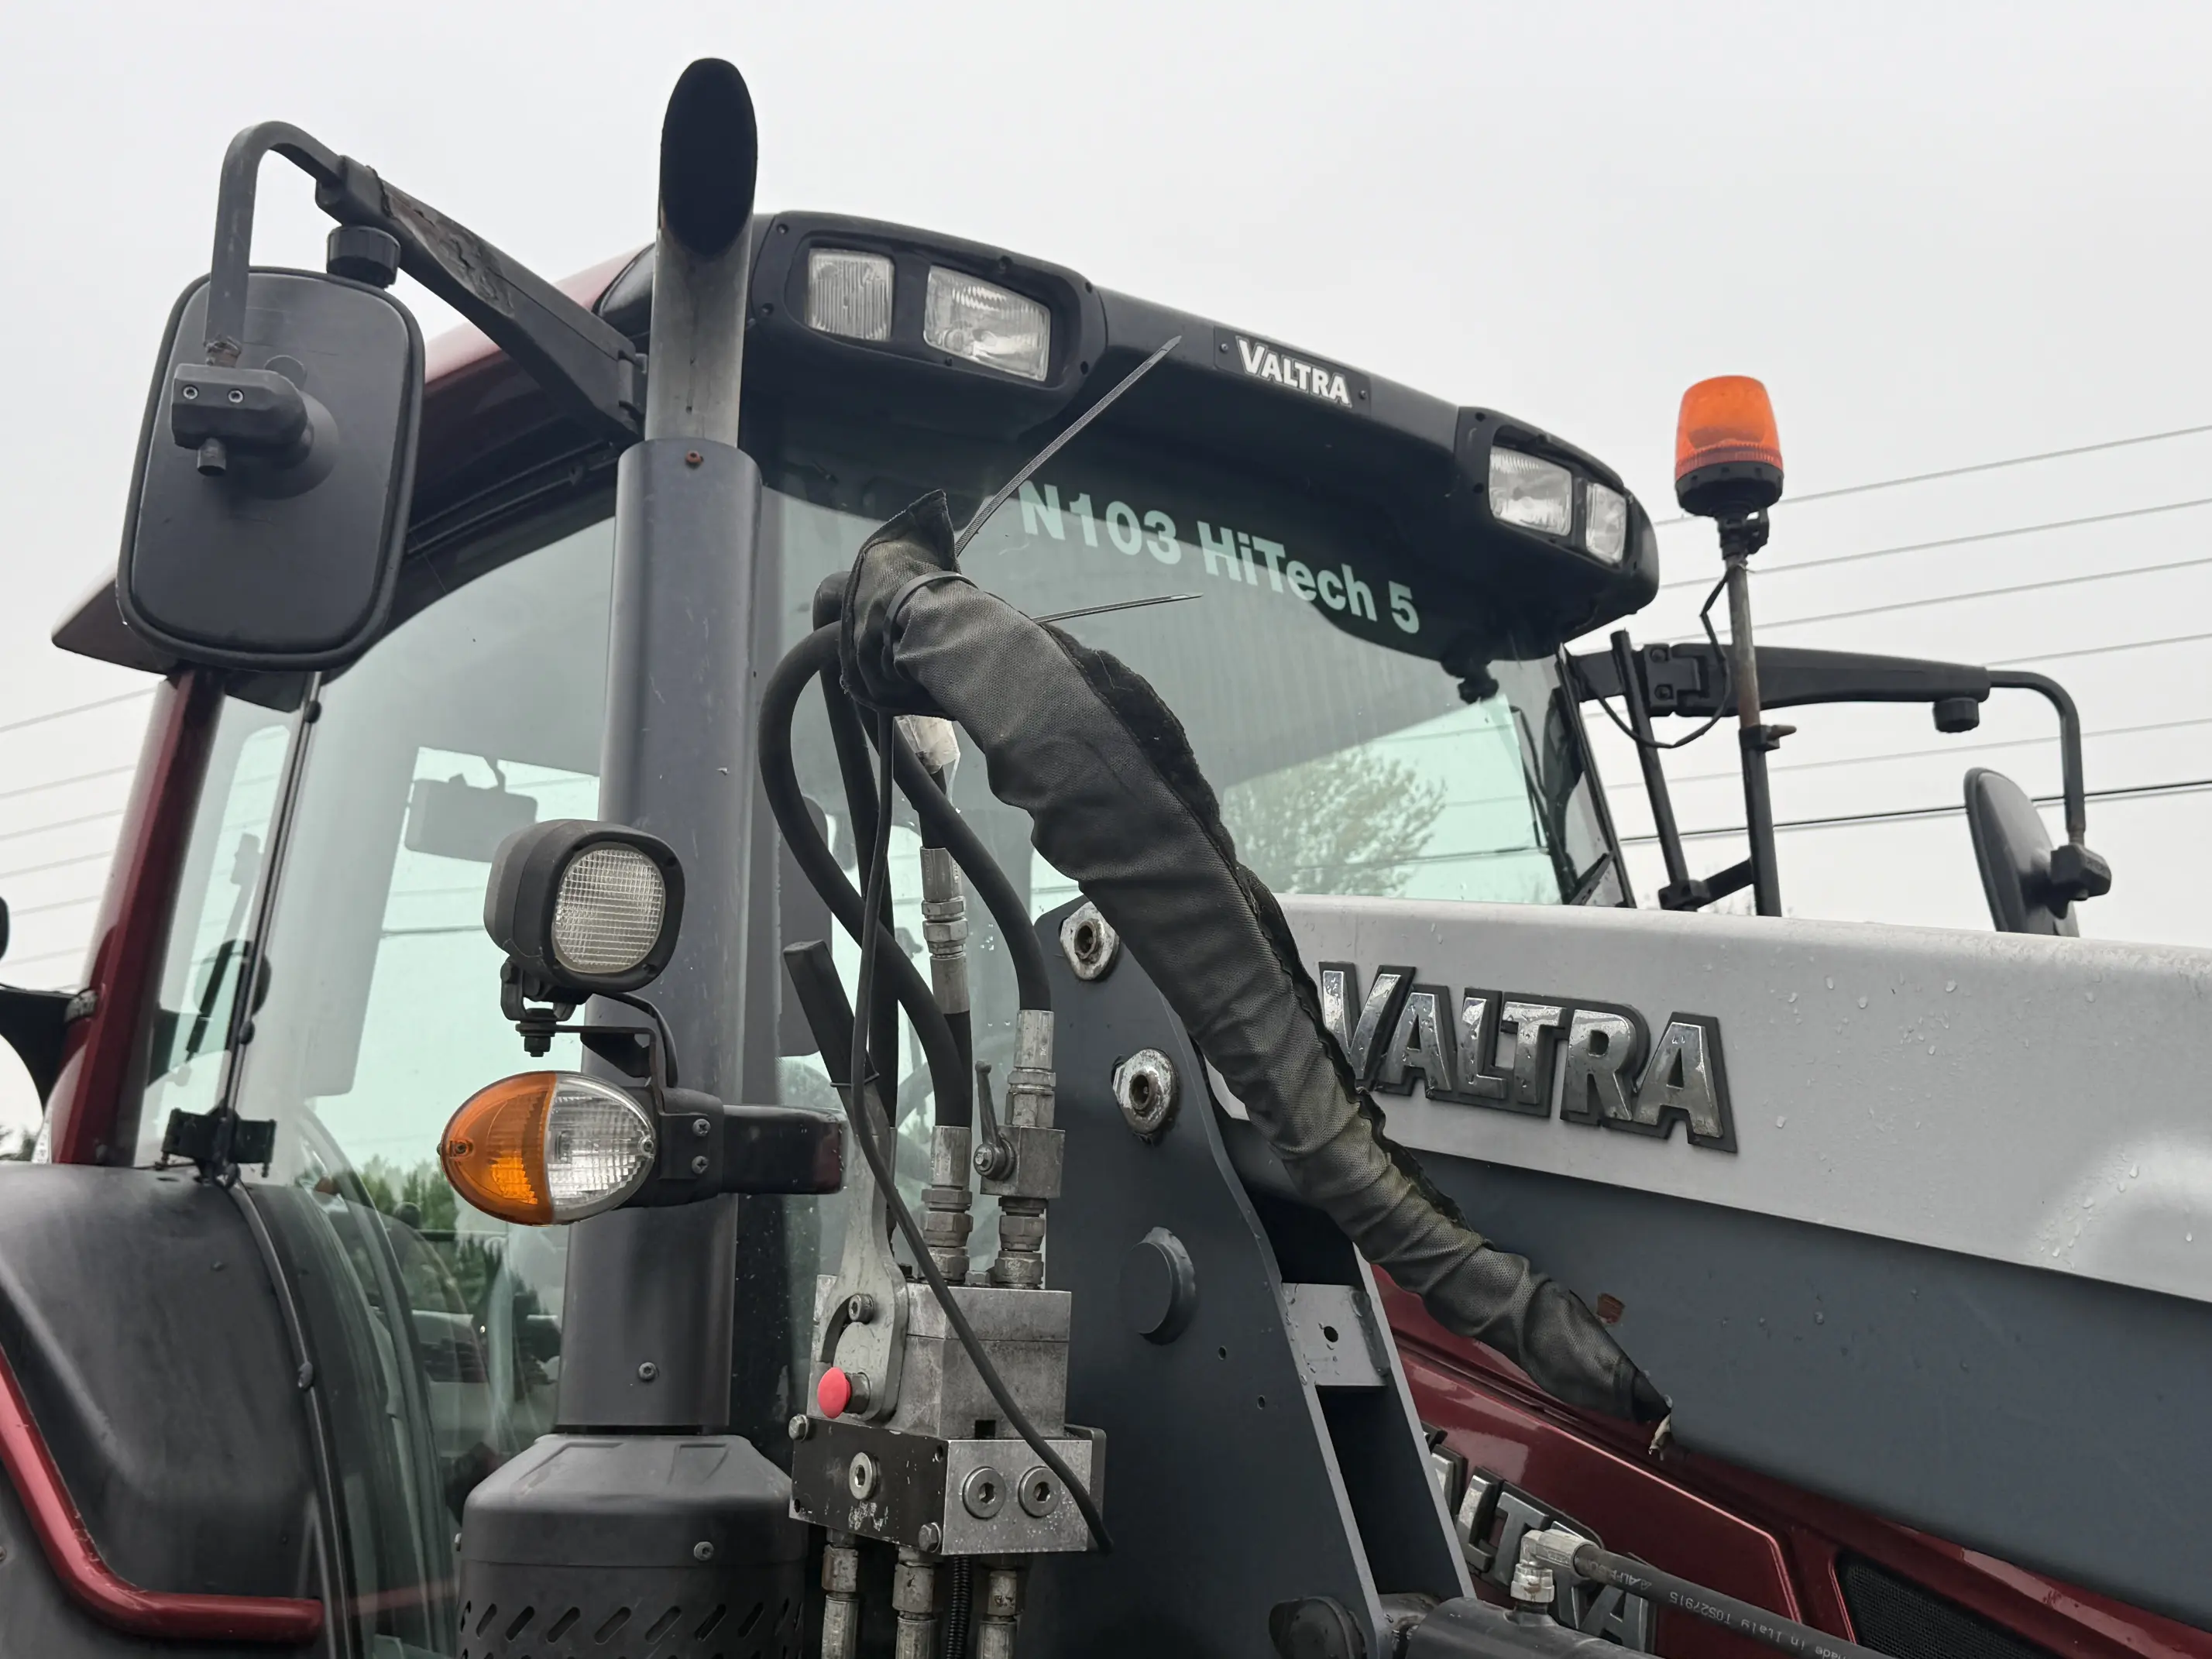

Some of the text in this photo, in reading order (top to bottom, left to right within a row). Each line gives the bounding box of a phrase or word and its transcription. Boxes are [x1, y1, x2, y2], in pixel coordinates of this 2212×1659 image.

[1237, 336, 1352, 407] VALTRA
[1018, 479, 1420, 634] N103 HiTech 5
[1320, 962, 1736, 1152] VALTRA
[1741, 1618, 1781, 1644] Italy
[1791, 1636, 1805, 1650] in
